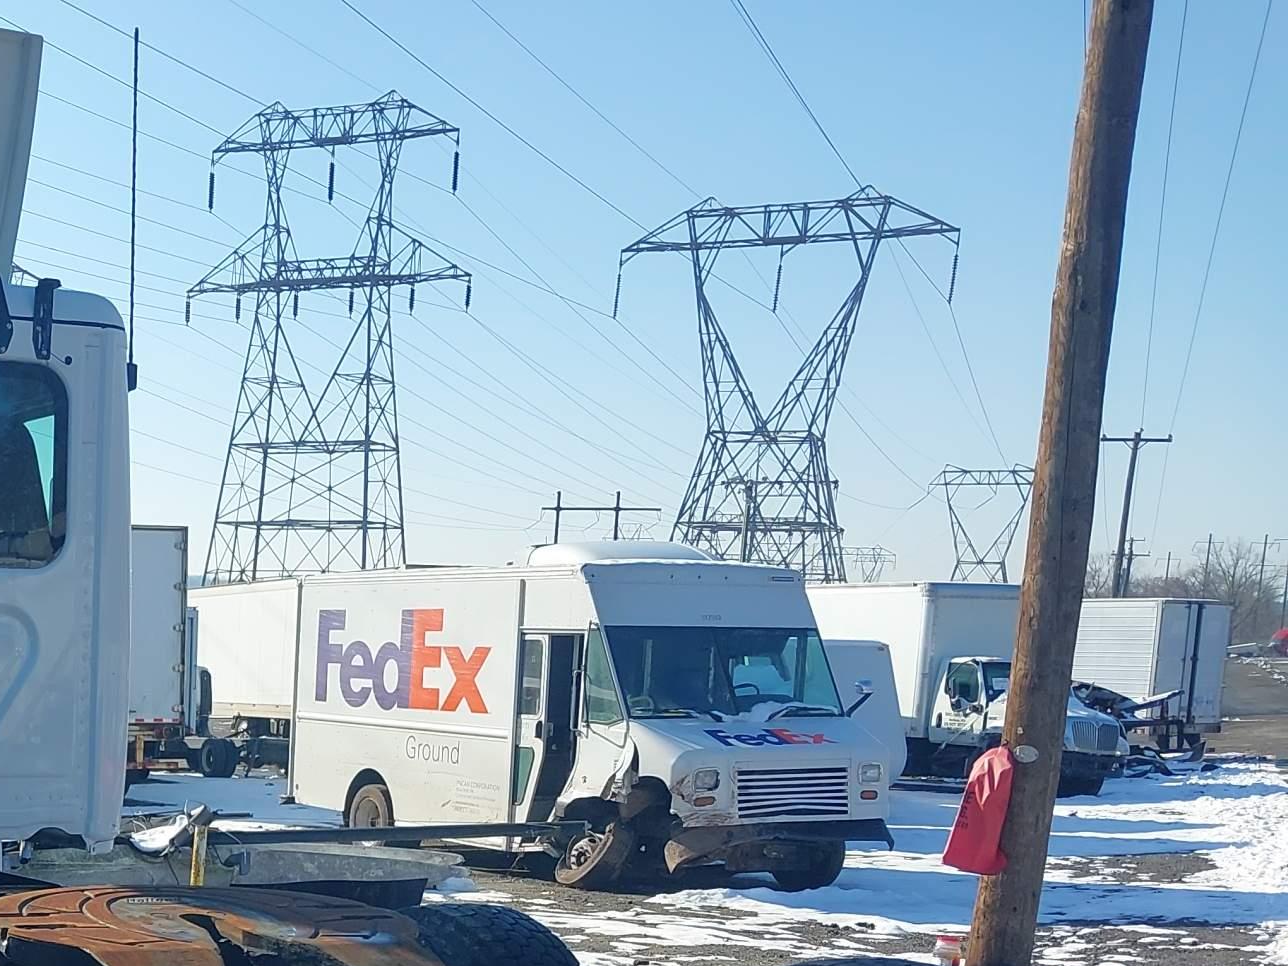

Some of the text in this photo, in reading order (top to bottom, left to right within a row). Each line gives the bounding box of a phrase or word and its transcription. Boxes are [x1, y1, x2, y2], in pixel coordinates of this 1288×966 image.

[315, 608, 492, 714] FedEx
[406, 735, 460, 764] Ground
[703, 728, 840, 746] FedEx
